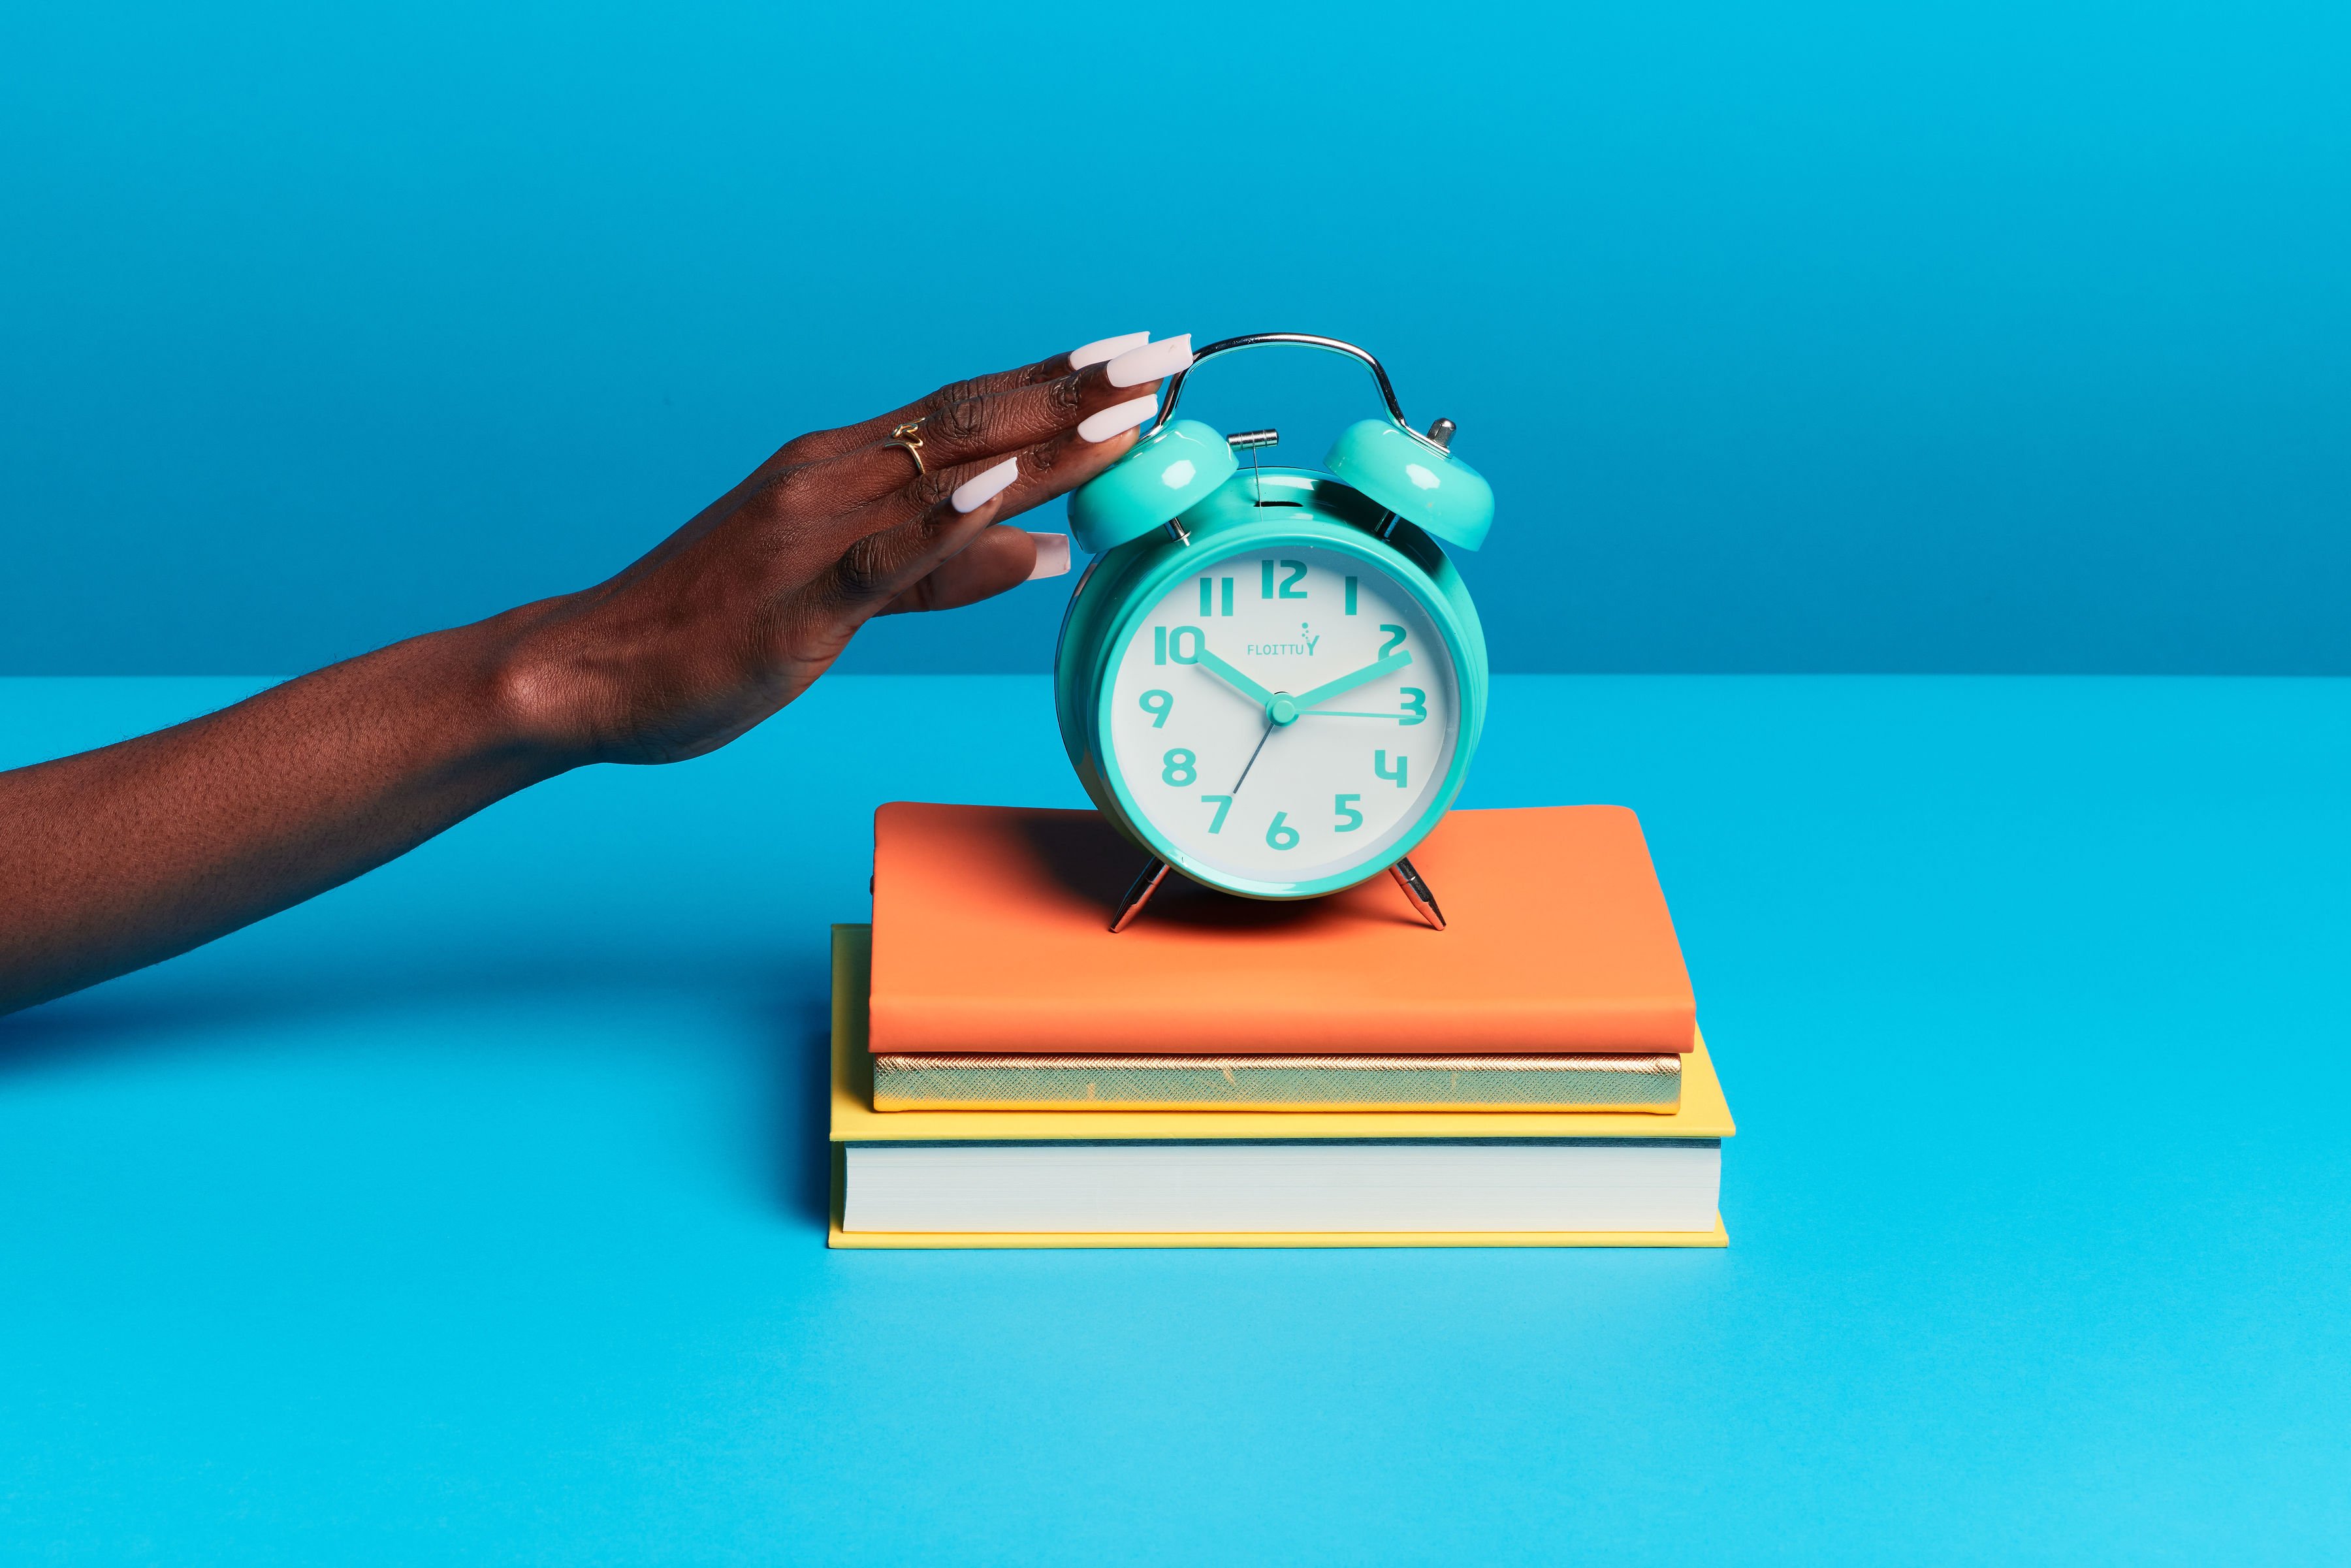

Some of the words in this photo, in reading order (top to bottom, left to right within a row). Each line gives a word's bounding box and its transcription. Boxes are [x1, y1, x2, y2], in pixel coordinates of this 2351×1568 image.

[1199, 577, 1234, 617] 11
[1261, 560, 1308, 600] 12
[1345, 576, 1358, 616] 1
[1154, 626, 1206, 665] 10
[1377, 624, 1407, 662] 2
[1138, 690, 1174, 729] 9
[1399, 687, 1428, 726] 3
[1161, 748, 1198, 788] 8
[1374, 750, 1408, 788] 4
[1200, 795, 1234, 835] 7
[1265, 811, 1301, 852] 6
[1334, 793, 1364, 833] 5
